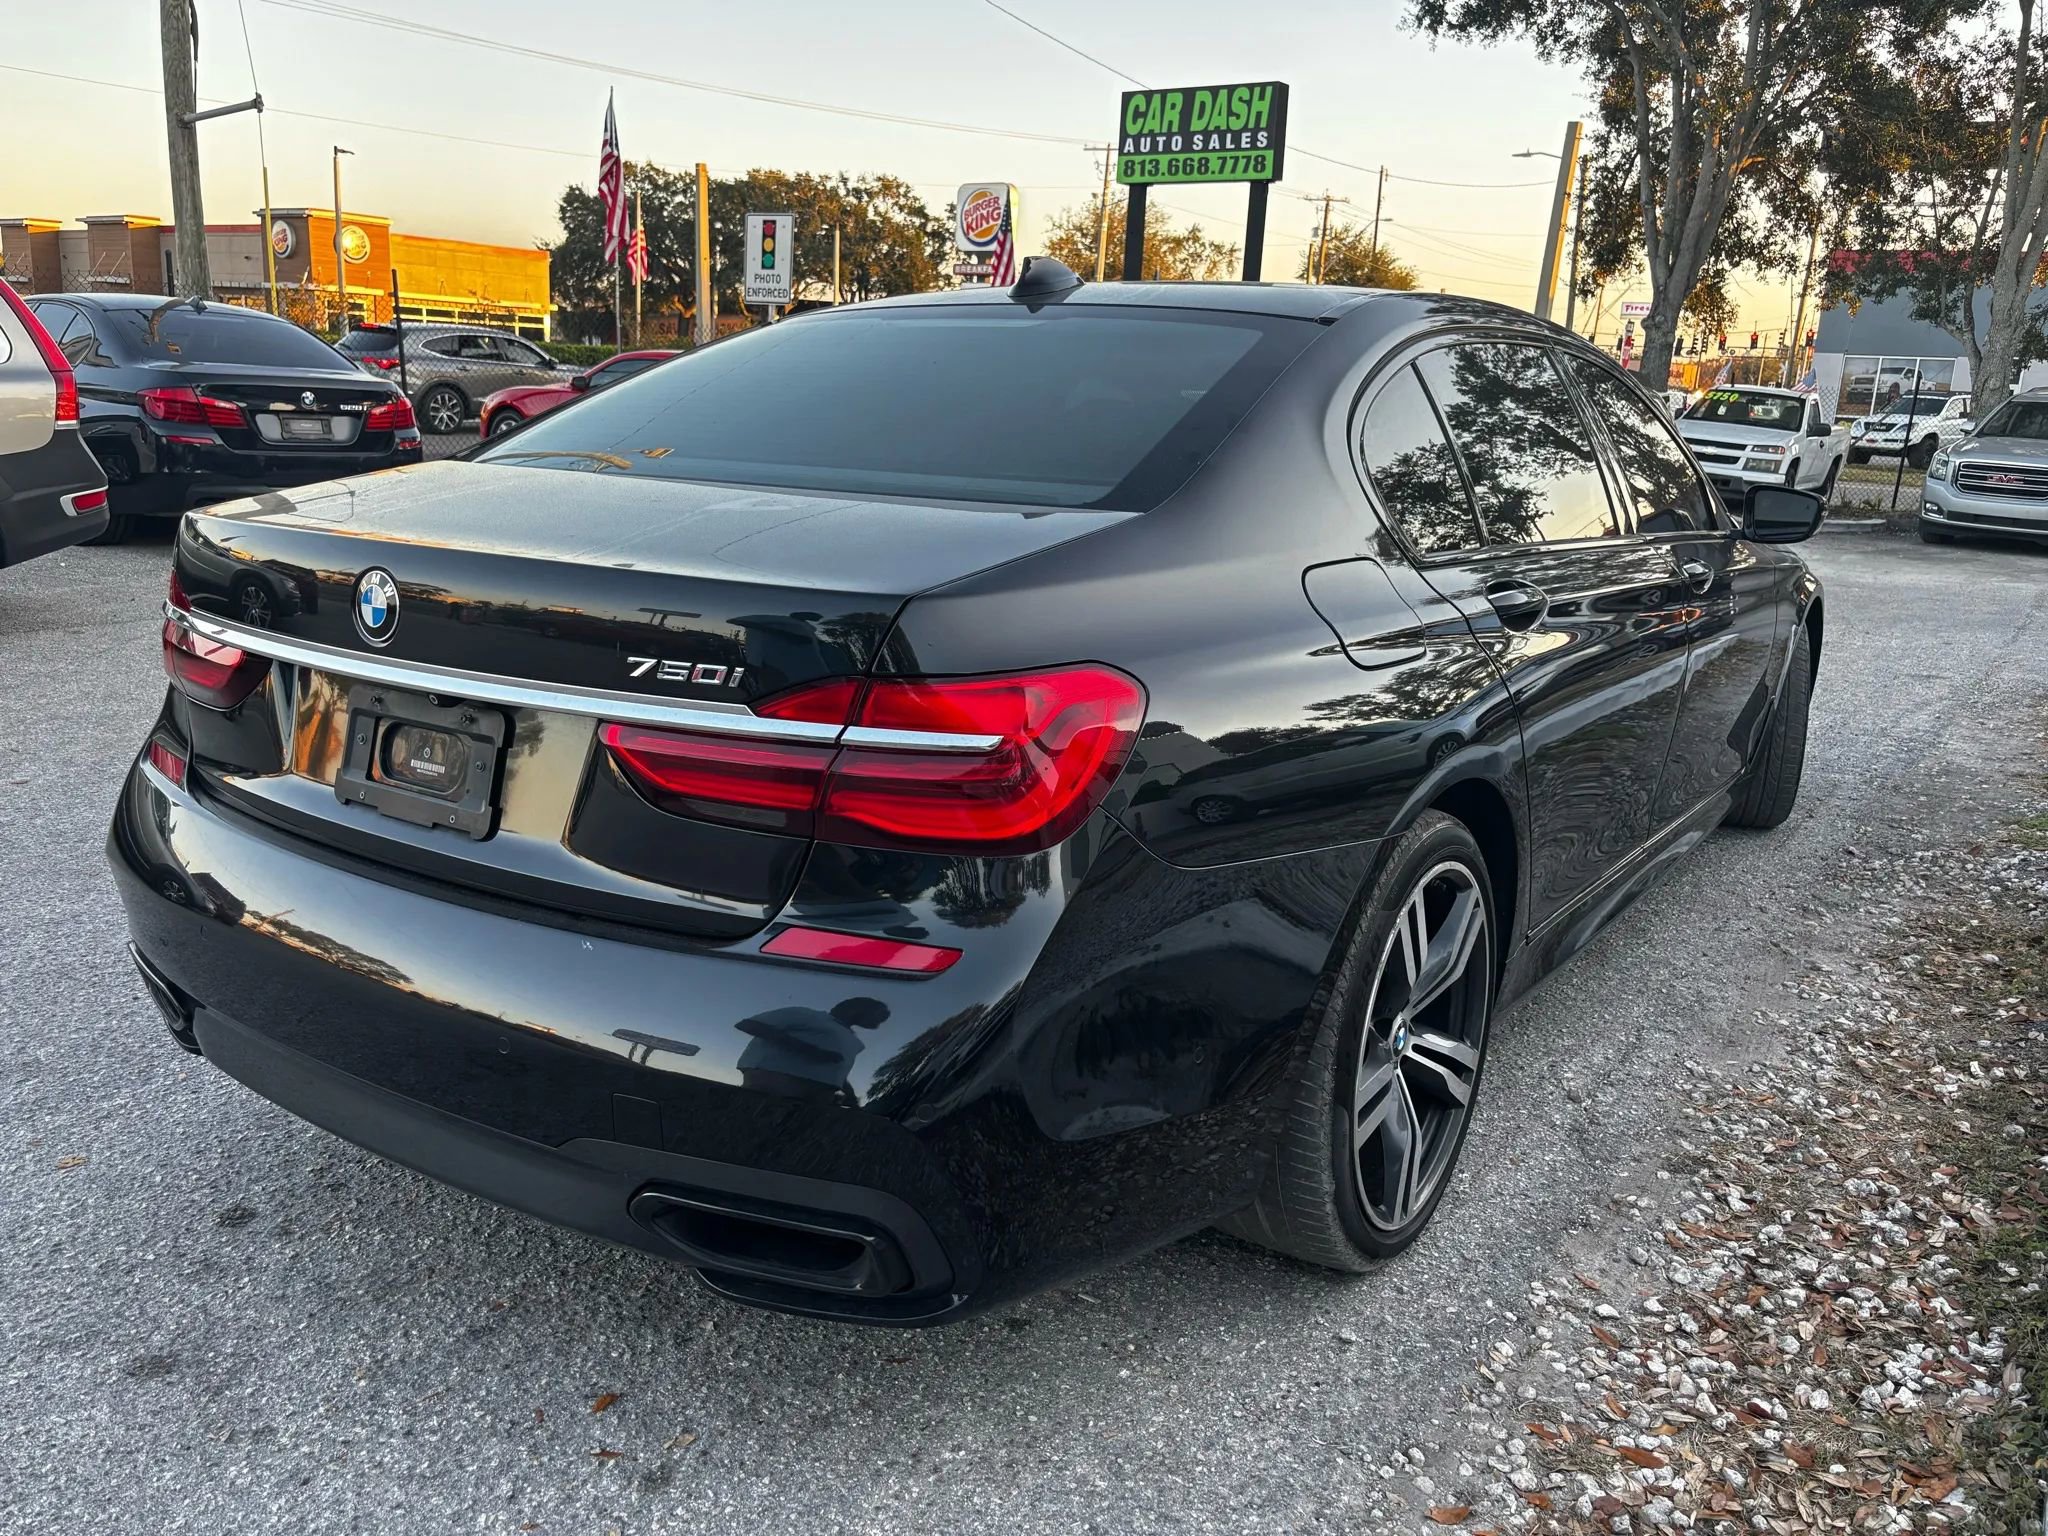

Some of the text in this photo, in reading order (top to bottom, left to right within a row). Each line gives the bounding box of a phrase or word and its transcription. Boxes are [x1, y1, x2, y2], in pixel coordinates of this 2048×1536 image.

[1125, 86, 1273, 136] CAR DASH
[1123, 131, 1268, 154] AUTO SALES
[1123, 154, 1267, 178] 813.668.7778
[964, 196, 1000, 220] BURGER
[965, 206, 1001, 237] KING
[955, 264, 994, 274] BREAKFA
[753, 273, 782, 285] PHOTO
[747, 287, 789, 299] ENFORCED
[1625, 304, 1650, 312] Fires
[1705, 391, 1739, 404] 5750
[1988, 474, 2025, 486] GMC
[626, 656, 745, 688] 750i
